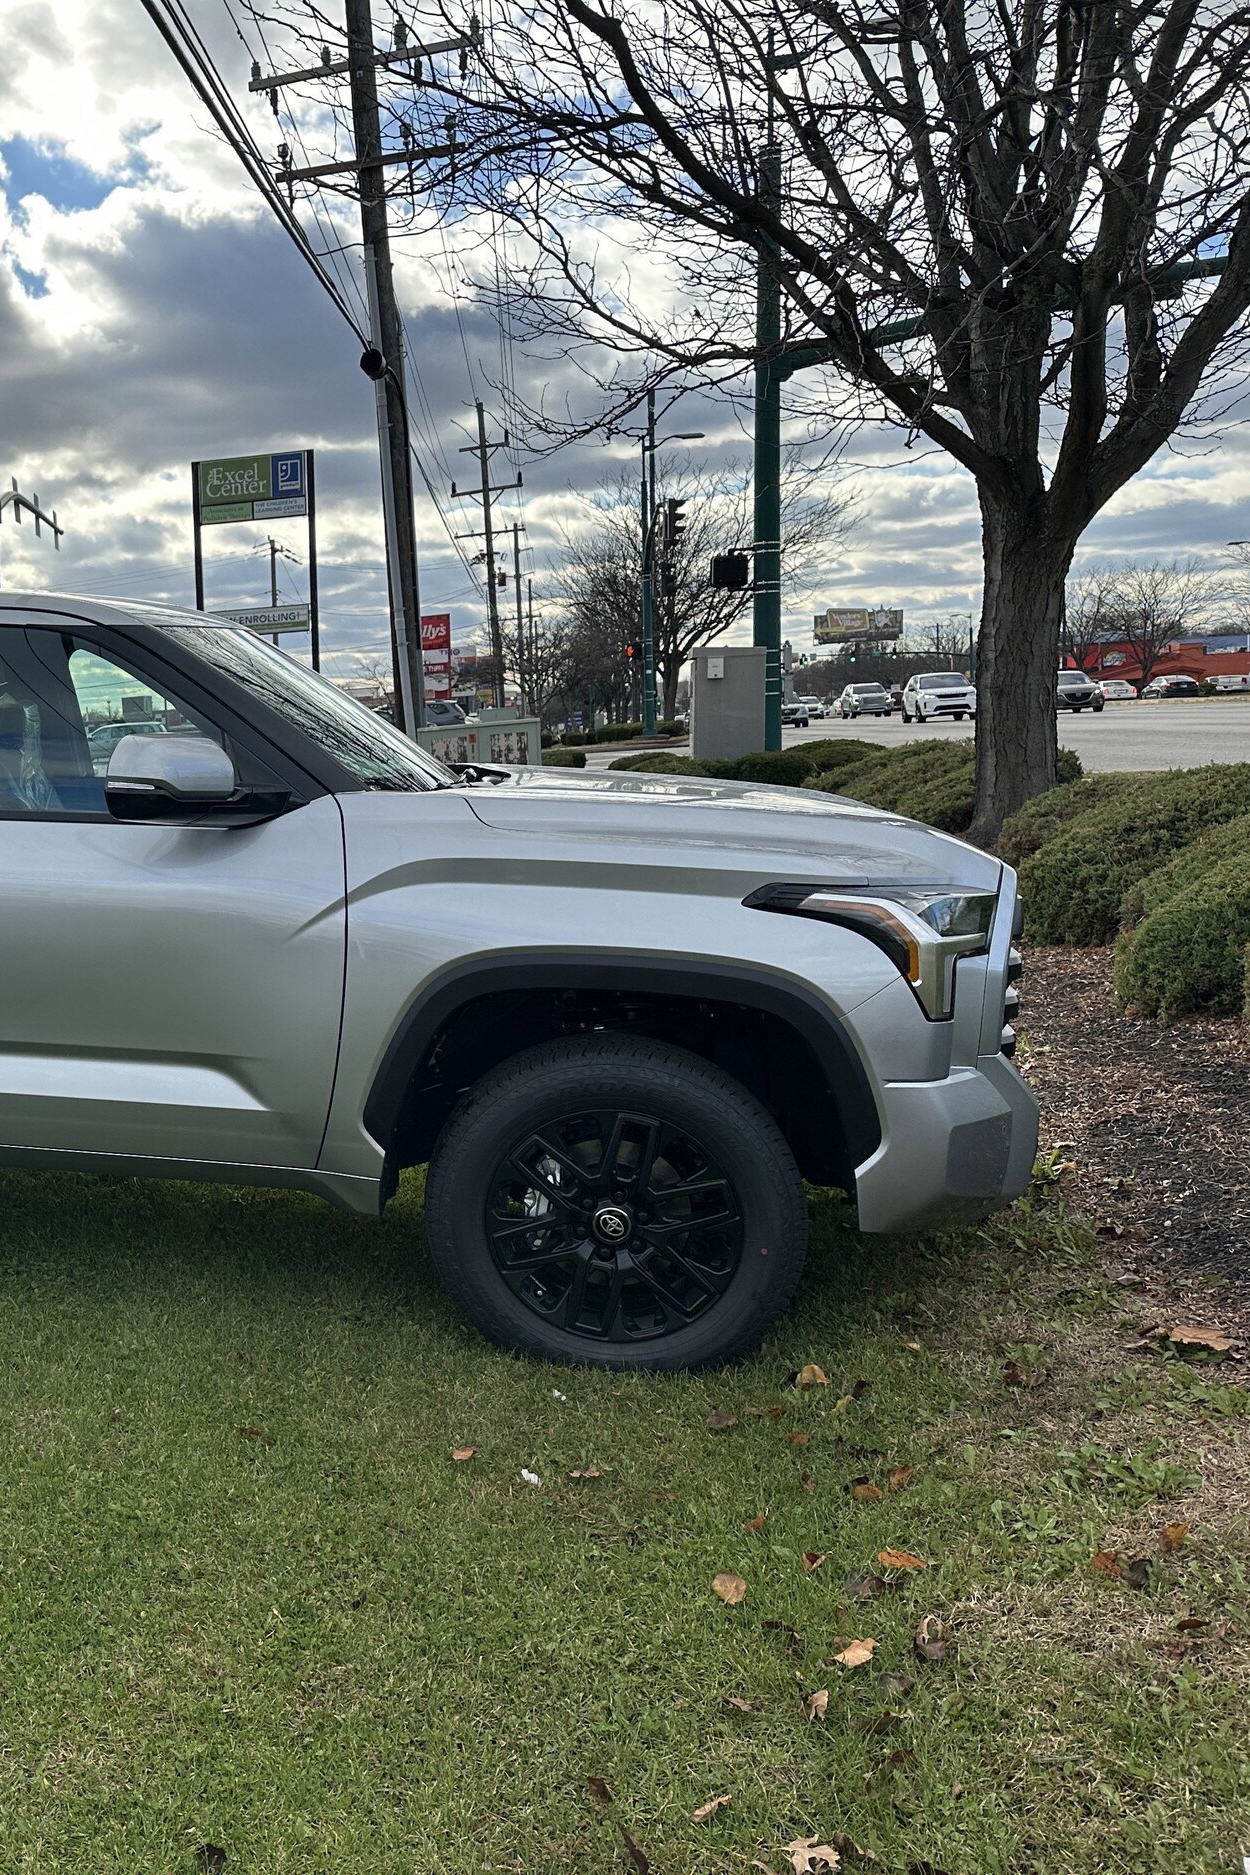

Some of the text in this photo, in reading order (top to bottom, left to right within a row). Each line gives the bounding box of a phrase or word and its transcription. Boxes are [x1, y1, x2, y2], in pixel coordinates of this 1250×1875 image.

[211, 463, 260, 485] Excel
[206, 479, 267, 498] Center
[255, 506, 283, 514] LEARNING
[239, 611, 300, 625] ENROLLING!
[422, 623, 447, 640] lly's
